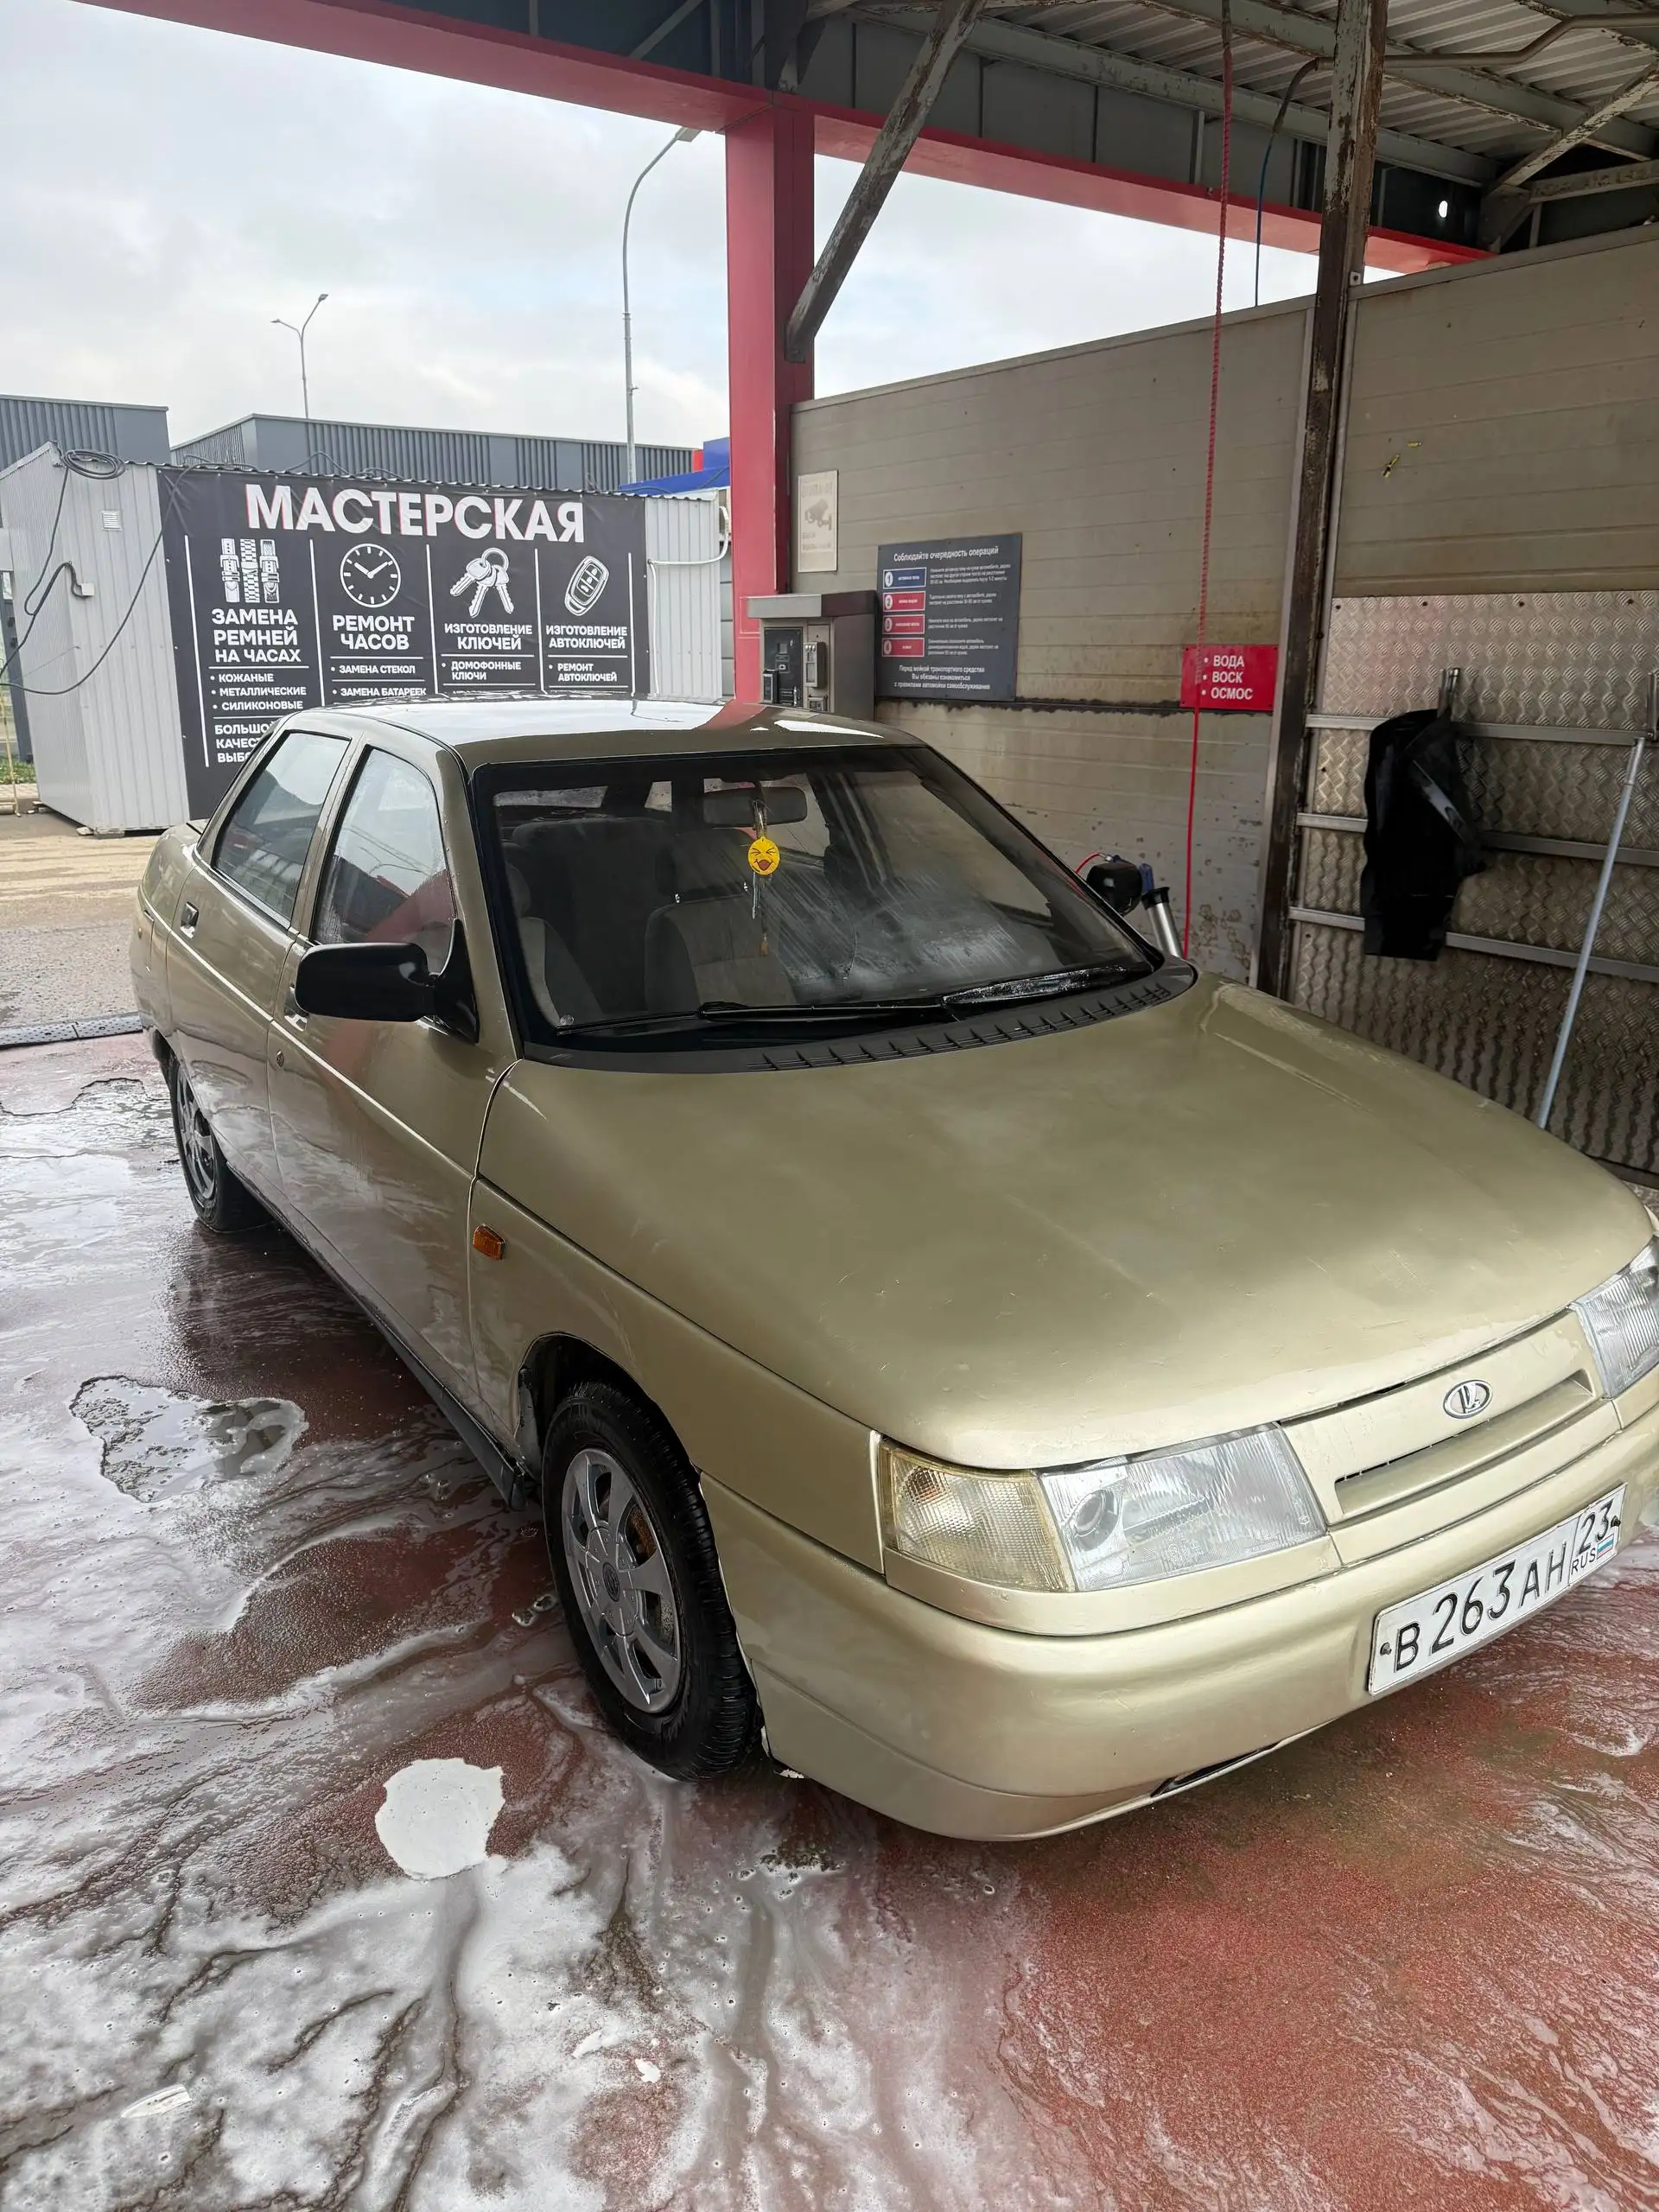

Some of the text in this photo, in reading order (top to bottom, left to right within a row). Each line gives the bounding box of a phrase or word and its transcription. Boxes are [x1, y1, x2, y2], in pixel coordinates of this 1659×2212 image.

[245, 483, 585, 543] МАСТЕРСКАЯ
[893, 546, 999, 562] Соблюдайте очередность операций
[212, 608, 298, 625] ЗАМЕНА
[333, 614, 415, 632] РЕМОНТ
[444, 623, 533, 635] ИЗГОТОВЛЕНИЕ
[213, 626, 298, 645] РЕМНЕЙ
[545, 625, 627, 637] ИЗГОТОВЛЕНИЕ
[340, 633, 410, 650] ЧАСОВ
[457, 634, 522, 650] КЛЮЧЕЙ
[549, 637, 626, 649] АВТОКЛЮЧЕЙ
[215, 649, 302, 663] НА ЧАСАХ
[1213, 655, 1245, 669] ВОДА
[339, 664, 416, 674] ЗАМЕНА СТЕКОЛ
[451, 661, 522, 671] ДОМОФОННЫЕ
[557, 663, 594, 671] РЕМОНТ
[218, 673, 274, 683] КОЖАНЫЕ
[452, 671, 486, 681] КЛЮЧИ
[558, 671, 617, 682] АВТОКЛЮЧЕЙ
[1211, 671, 1244, 683] ВОСК
[219, 687, 307, 696] МЕТАЛЛИЧЕСКИЕ
[340, 688, 426, 696] ЗАМЕНА БАТАРЕЕК
[1211, 687, 1253, 700] ОСМОС
[221, 701, 303, 710] СИЛИКОНОВЫЕ
[214, 721, 273, 734] БОЛЬШО
[1578, 1498, 1614, 1554] 23
[1571, 1548, 1596, 1575] RUS
